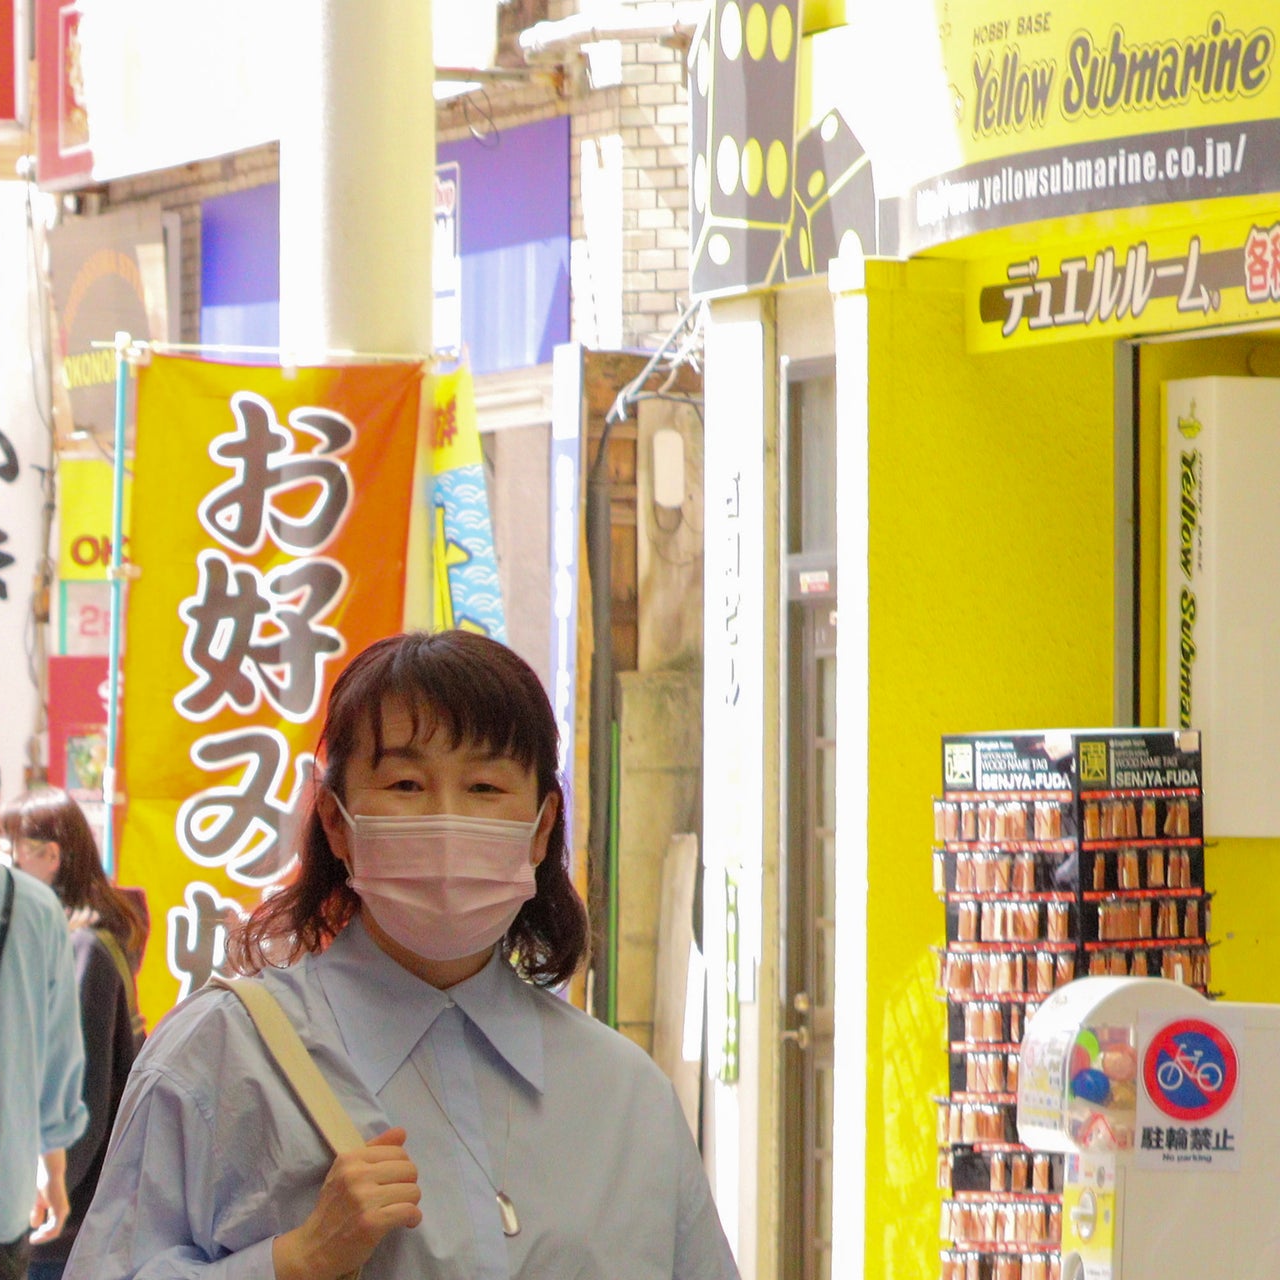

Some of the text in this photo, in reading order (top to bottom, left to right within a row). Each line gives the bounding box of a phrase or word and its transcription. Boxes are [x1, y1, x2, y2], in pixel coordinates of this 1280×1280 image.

[973, 11, 1052, 47] HOBBY BASE
[971, 12, 1276, 138] Yellow Submarine
[1141, 1126, 1235, 1151] 駐輪禁止
[1162, 1153, 1213, 1164] No parking
